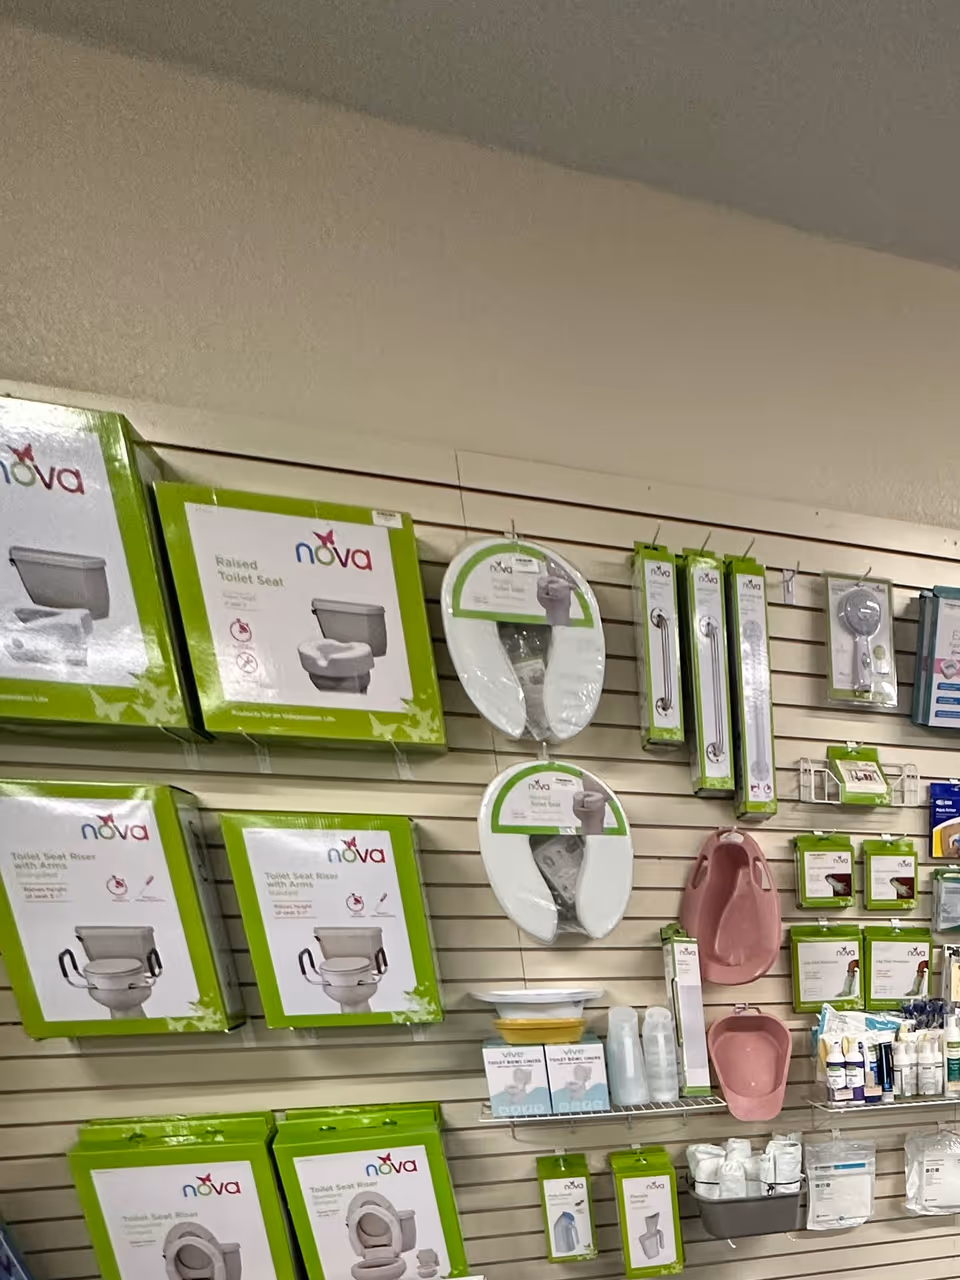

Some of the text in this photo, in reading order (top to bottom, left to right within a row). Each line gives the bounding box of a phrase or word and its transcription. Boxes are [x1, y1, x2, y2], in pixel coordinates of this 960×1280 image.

[215, 555, 258, 571] Raised
[295, 541, 373, 572] nova
[217, 570, 285, 588] Toilet Seat
[82, 821, 150, 842] nova
[10, 852, 42, 861] Toilet
[44, 852, 68, 861] Seat
[327, 845, 387, 865] nova
[14, 862, 38, 870] with
[836, 948, 856, 957] nova
[907, 948, 926, 957] nova
[366, 1158, 418, 1177] nova
[182, 1180, 241, 1198] nova
[564, 1182, 584, 1190] nova
